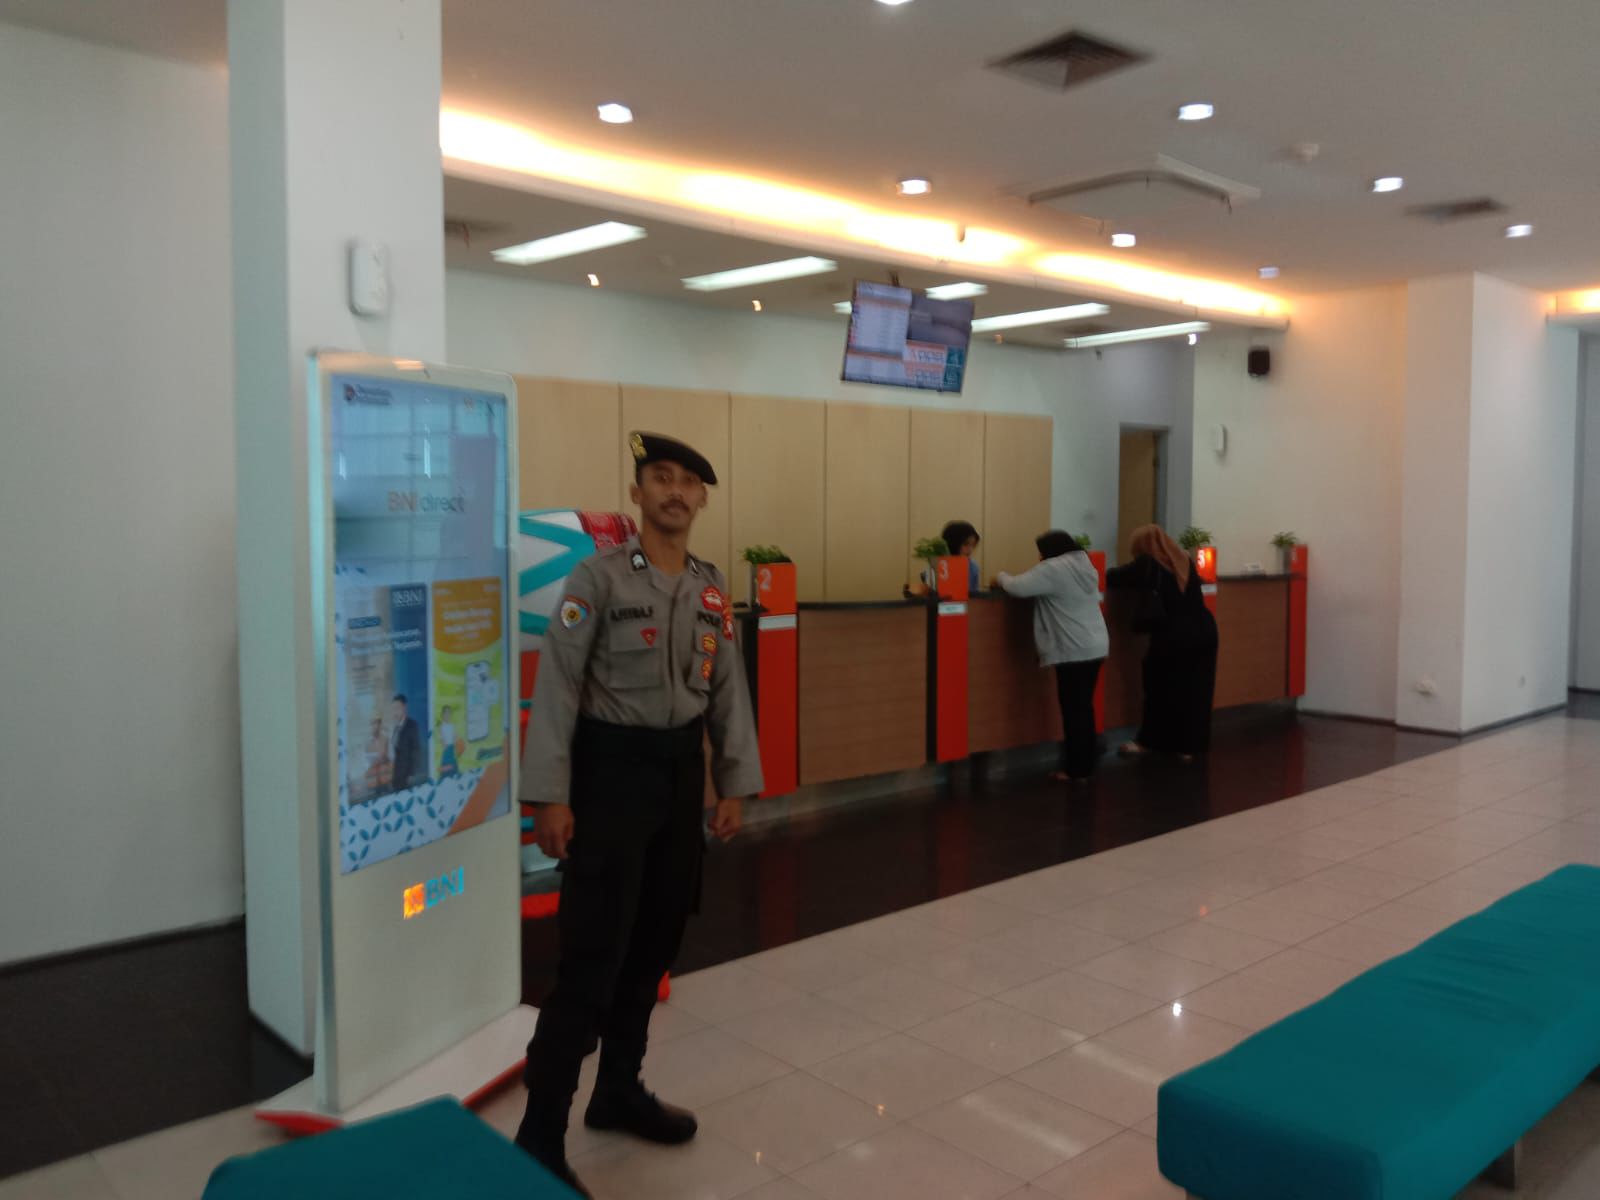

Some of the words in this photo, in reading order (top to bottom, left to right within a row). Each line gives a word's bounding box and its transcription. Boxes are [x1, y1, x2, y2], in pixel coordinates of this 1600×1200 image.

[420, 489, 464, 512] direct
[759, 567, 772, 591] 2
[939, 559, 950, 581] 3
[416, 864, 465, 895] BNI
